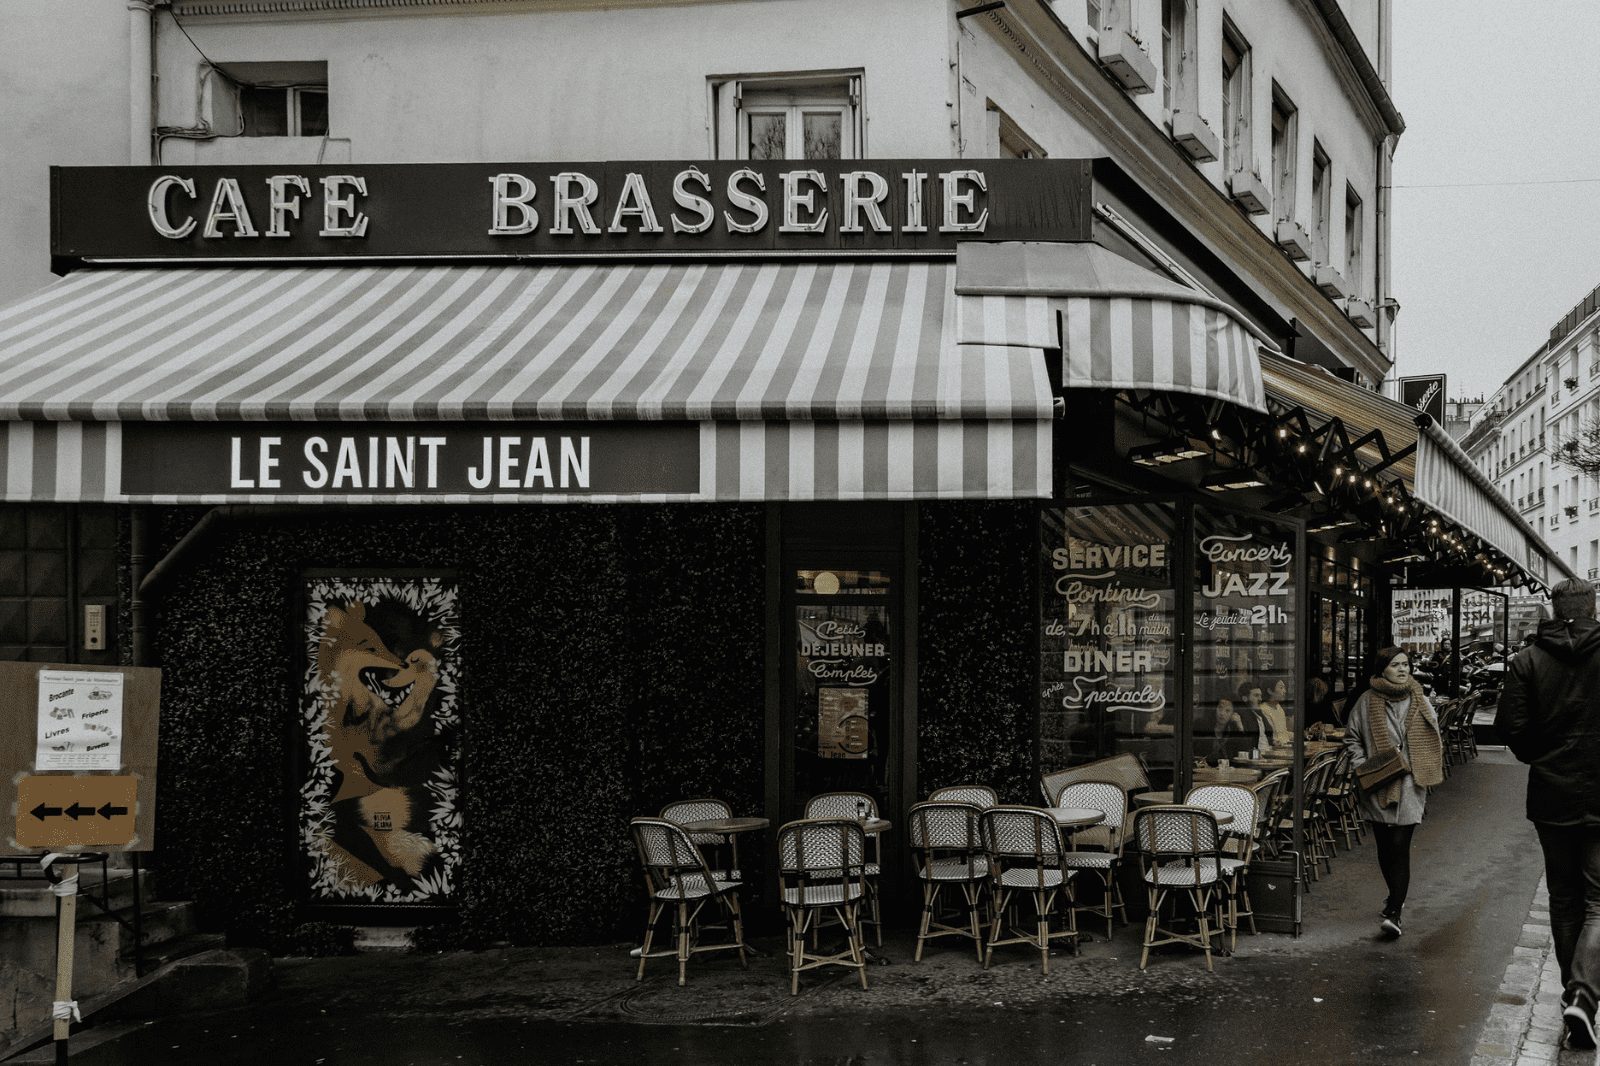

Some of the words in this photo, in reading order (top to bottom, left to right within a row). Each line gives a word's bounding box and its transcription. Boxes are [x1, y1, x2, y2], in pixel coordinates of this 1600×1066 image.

[148, 174, 369, 239] CAFE
[488, 165, 990, 237] BRASSERIE
[231, 436, 282, 489] LE
[302, 436, 447, 489] SAINT
[467, 436, 591, 489] JEAN
[1052, 544, 1165, 570] SERVICE
[1200, 533, 1292, 568] Concert
[1055, 571, 1160, 610] Continu
[1202, 572, 1289, 598] JAZZ
[1195, 612, 1209, 628] Le
[1209, 612, 1237, 631] jeudi
[1250, 604, 1288, 625] 21h
[816, 621, 866, 641] Petit
[807, 659, 878, 687] Complet
[1063, 650, 1151, 673] DINER
[49, 687, 74, 702] Brocante
[1062, 675, 1166, 712] Spectacles
[81, 707, 109, 720] Friperie
[44, 727, 70, 739] Livres
[86, 741, 110, 752] Buvette
